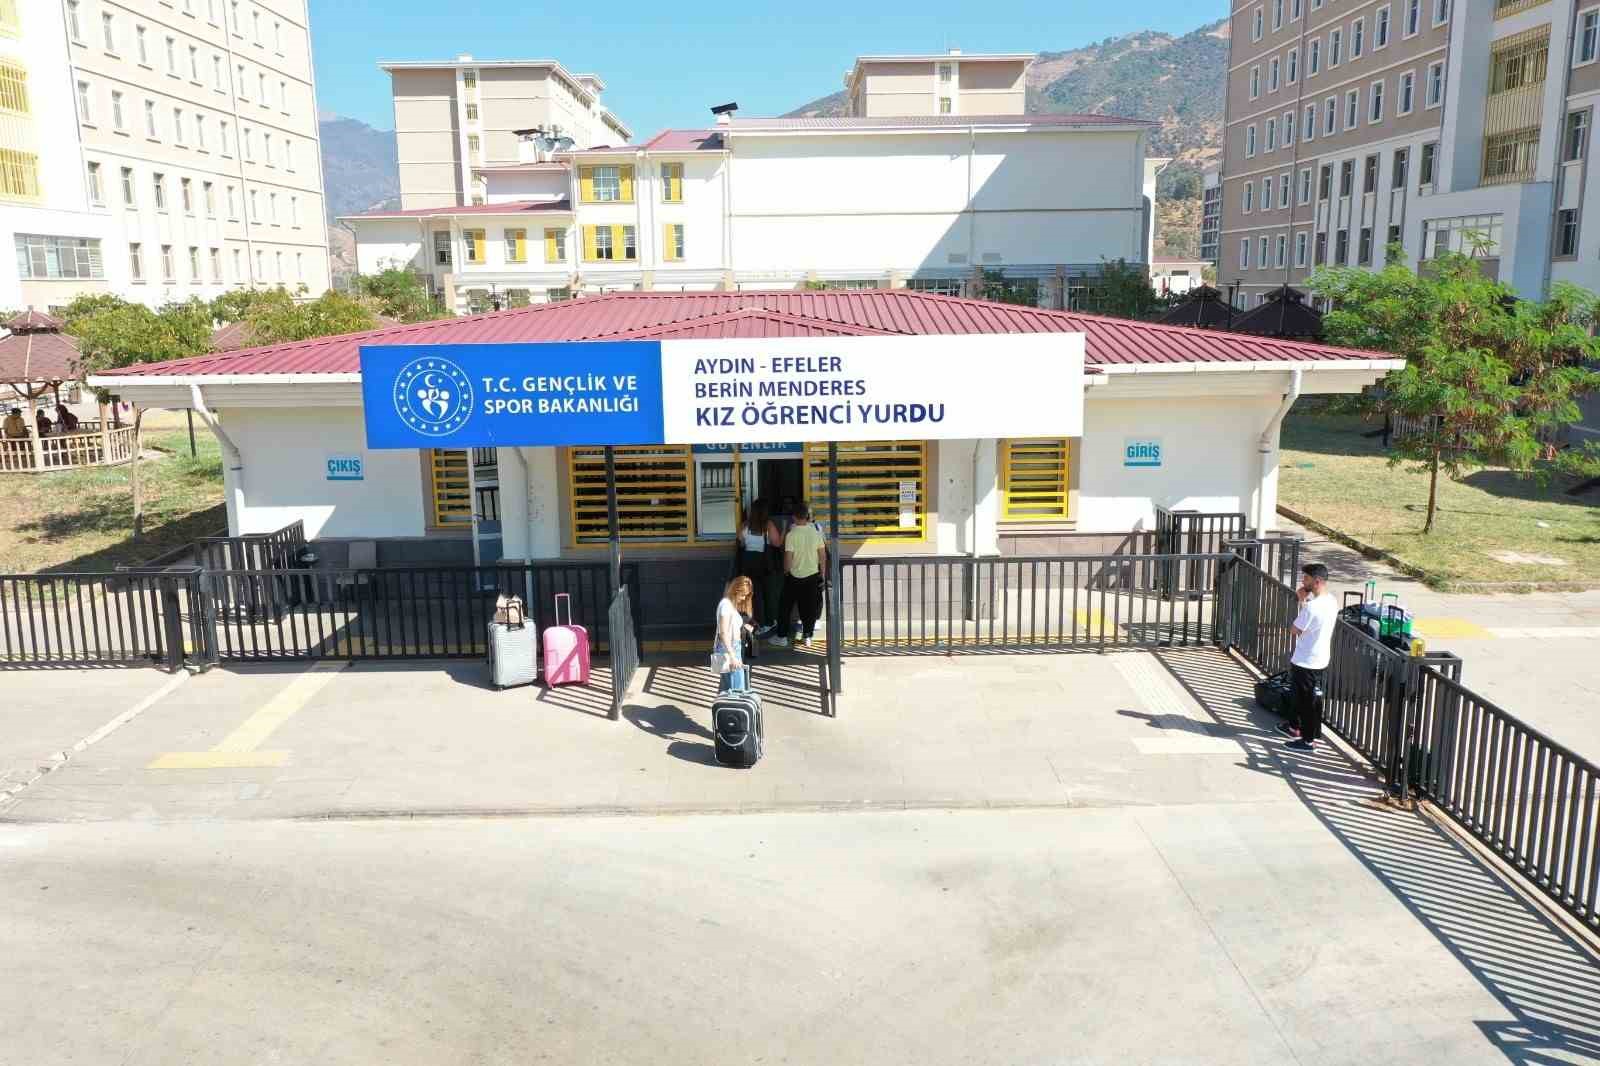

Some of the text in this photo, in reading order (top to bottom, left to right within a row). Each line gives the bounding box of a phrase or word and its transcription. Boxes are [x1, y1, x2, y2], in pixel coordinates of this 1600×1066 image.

[694, 358, 755, 375] AYDIN
[771, 356, 842, 374] EFELER
[482, 373, 637, 396] T.C. GENÇLİK VE
[695, 378, 866, 399] BERİN MENDERES
[484, 394, 639, 415] SPOR BAKANLIĞI
[696, 399, 945, 426] KIZ ÖĞRENCİ YURDU
[327, 459, 361, 475] ÇIKIŞ
